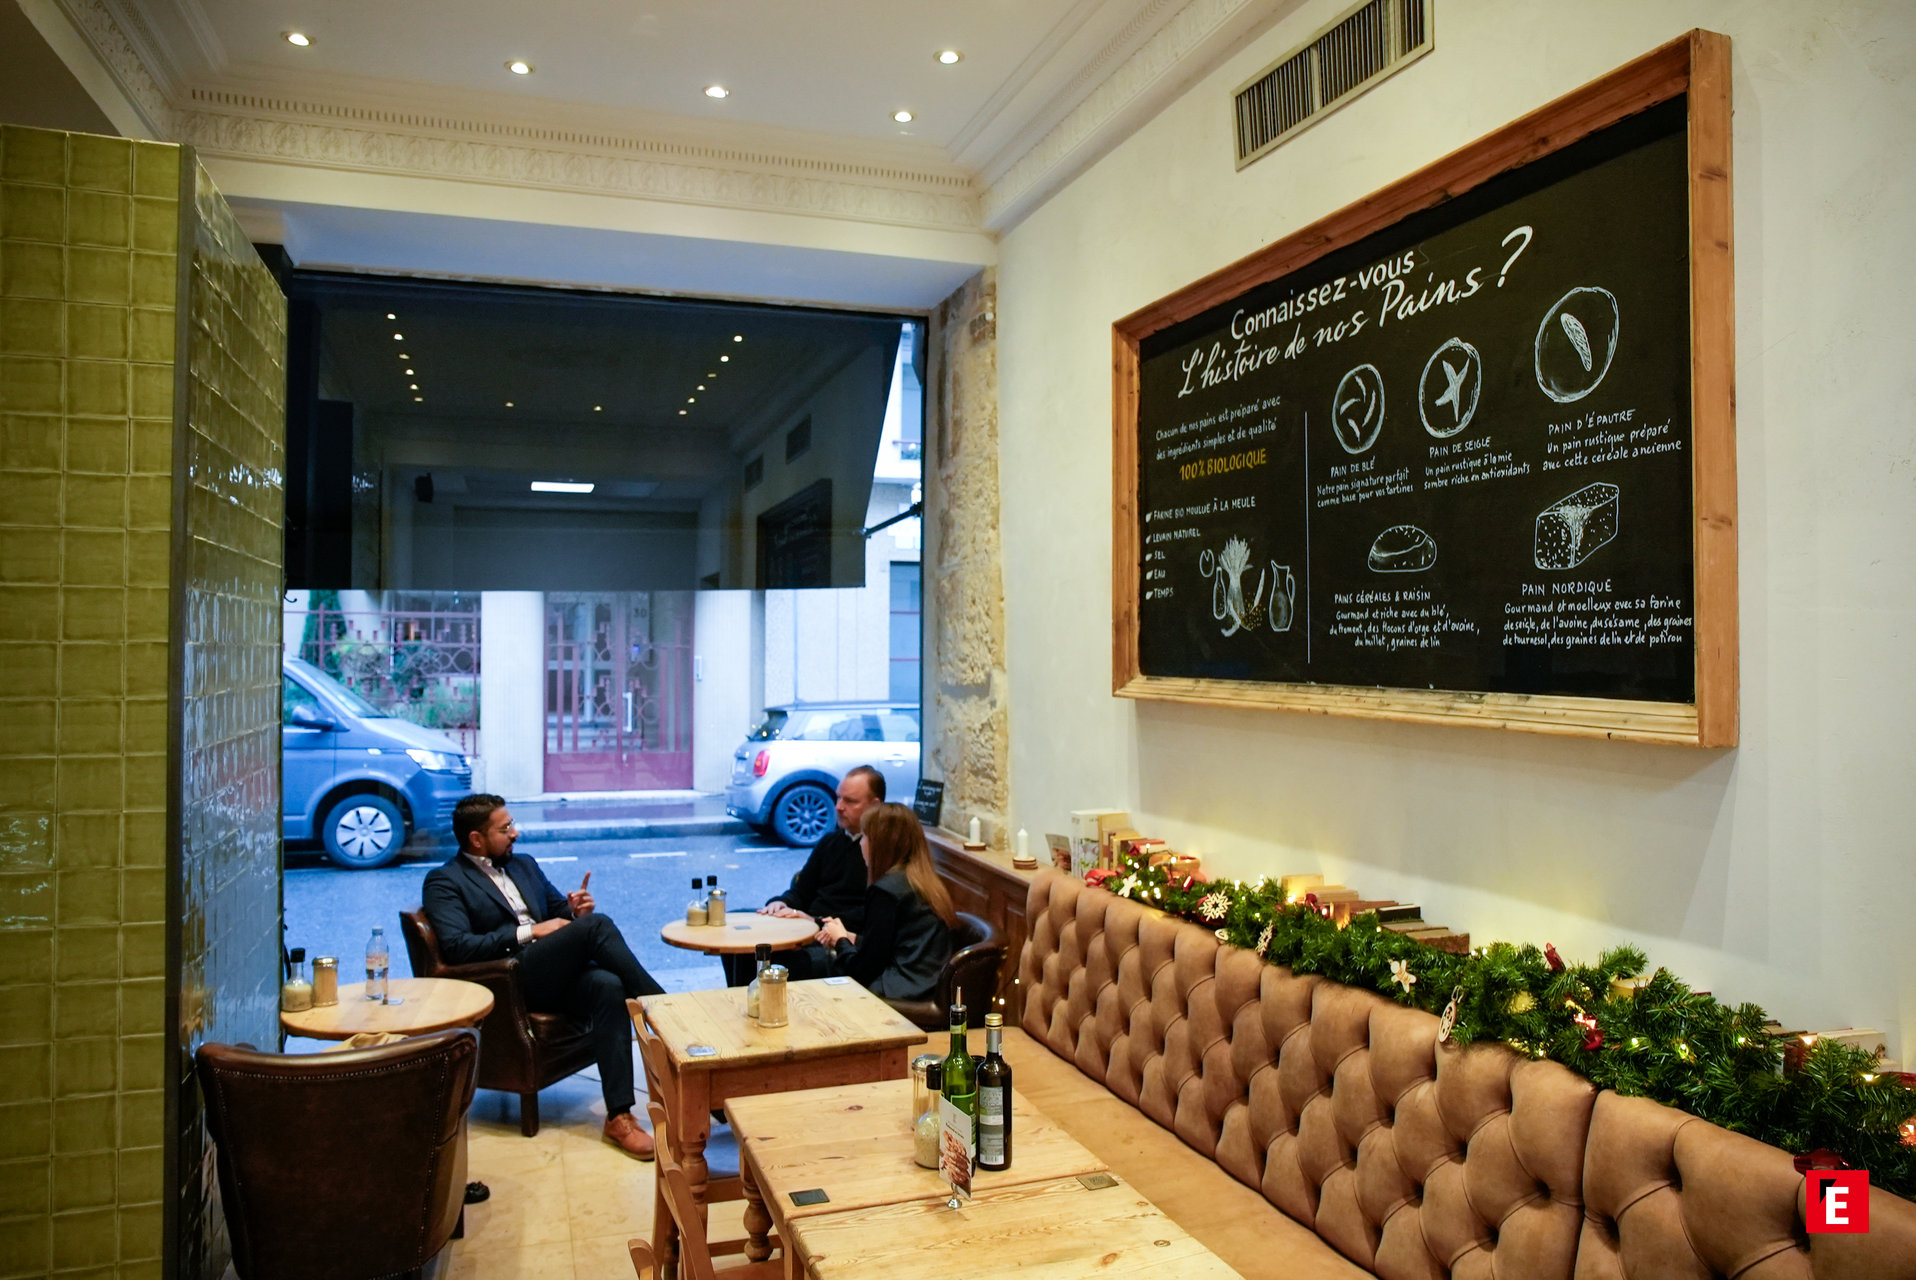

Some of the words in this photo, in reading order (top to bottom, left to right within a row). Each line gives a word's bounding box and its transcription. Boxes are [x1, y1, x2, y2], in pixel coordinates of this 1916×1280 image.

[1231, 251, 1415, 340] Connaissez-vous
[1178, 340, 1280, 398] L'histoire
[1284, 323, 1306, 360] de
[1313, 310, 1369, 348] nos
[1379, 267, 1485, 327] Pains
[1497, 225, 1533, 288] ?
[1156, 428, 1178, 440] Chacun
[1180, 423, 1187, 433] de
[1189, 421, 1198, 430] nos
[1200, 412, 1216, 432] pains
[1218, 408, 1228, 422] est
[1262, 396, 1280, 410] avec
[1548, 422, 1572, 436] PAIN
[1156, 448, 1166, 460] des
[1168, 438, 1200, 460] ingrédients
[1203, 432, 1226, 450] simples
[1228, 429, 1236, 442] et
[1236, 427, 1246, 440] de
[1248, 417, 1277, 440] qualité
[1430, 446, 1448, 458] PAIN
[1452, 443, 1462, 453] DE
[1464, 436, 1491, 452] SEIGLE
[1548, 442, 1558, 454] Un
[1562, 436, 1582, 454] pain
[1584, 430, 1625, 452] rustique
[1630, 418, 1670, 442] préparé
[1179, 460, 1204, 480] 100%
[1207, 448, 1267, 476] BIOLOGIQUE
[1331, 465, 1346, 478] PAIN
[1350, 463, 1360, 473] DE
[1362, 455, 1376, 472] BLÉ
[1425, 467, 1434, 476] Un
[1436, 463, 1450, 476] pain
[1452, 457, 1482, 472] rustique
[1490, 452, 1497, 464] la
[1498, 450, 1512, 462] mie
[1542, 460, 1560, 472] avec
[1564, 452, 1588, 467] cette
[1632, 440, 1682, 458] ancienne
[1317, 484, 1334, 496] Notre
[1336, 479, 1350, 495] pain
[1351, 476, 1384, 492] signature
[1386, 466, 1410, 486] parfait
[1424, 478, 1448, 490] sombre
[1451, 474, 1470, 485] riche
[1471, 474, 1480, 482] en
[1318, 497, 1340, 508] comme
[1342, 493, 1356, 504] base
[1359, 490, 1374, 504] pour
[1375, 488, 1385, 498] vos
[1386, 482, 1414, 495] tartines
[1154, 509, 1172, 520] FARINE
[1175, 508, 1184, 518] BIO
[1186, 504, 1210, 516] MOULUE
[1220, 500, 1229, 512] LA
[1232, 496, 1256, 510] MEULE
[1153, 532, 1172, 543] LEVAIN
[1174, 528, 1200, 540] NATUREL
[1154, 550, 1166, 560] SEL
[1154, 569, 1166, 579] EAU
[1154, 587, 1174, 598] TEMPS
[1334, 593, 1352, 604] PAINS
[1394, 590, 1400, 602] &
[1403, 585, 1430, 601] RAISIN
[1522, 584, 1545, 596] PAIN
[1552, 578, 1612, 595] NORDIQUE
[1336, 608, 1368, 620] Gourmand
[1372, 608, 1379, 619] et
[1380, 606, 1398, 619] riche
[1402, 610, 1418, 618] avec
[1420, 608, 1429, 618] du
[1504, 601, 1554, 614] Gourmand
[1558, 600, 1566, 612] et
[1568, 596, 1612, 612] moelleux
[1615, 600, 1632, 610] avec
[1635, 599, 1646, 609] sa
[1650, 594, 1680, 609] farine
[1330, 624, 1338, 636] du
[1368, 622, 1379, 633] des
[1382, 620, 1406, 634] flocons
[1408, 620, 1430, 636] d'orge
[1433, 620, 1441, 633] et
[1504, 619, 1514, 630] de
[1540, 618, 1550, 630] de
[1592, 616, 1603, 628] du
[1648, 613, 1662, 628] des
[1664, 614, 1692, 635] graines
[1354, 636, 1364, 647] du
[1391, 636, 1418, 652] graines
[1420, 637, 1428, 648] de
[1430, 635, 1440, 648] lin
[1503, 634, 1512, 646] de
[1551, 631, 1564, 644] des
[1566, 631, 1597, 649] graines
[1600, 632, 1610, 645] de
[1612, 630, 1622, 644] lin
[1624, 630, 1635, 644] et
[1636, 630, 1645, 644] de
[1650, 631, 1682, 648] potiron
